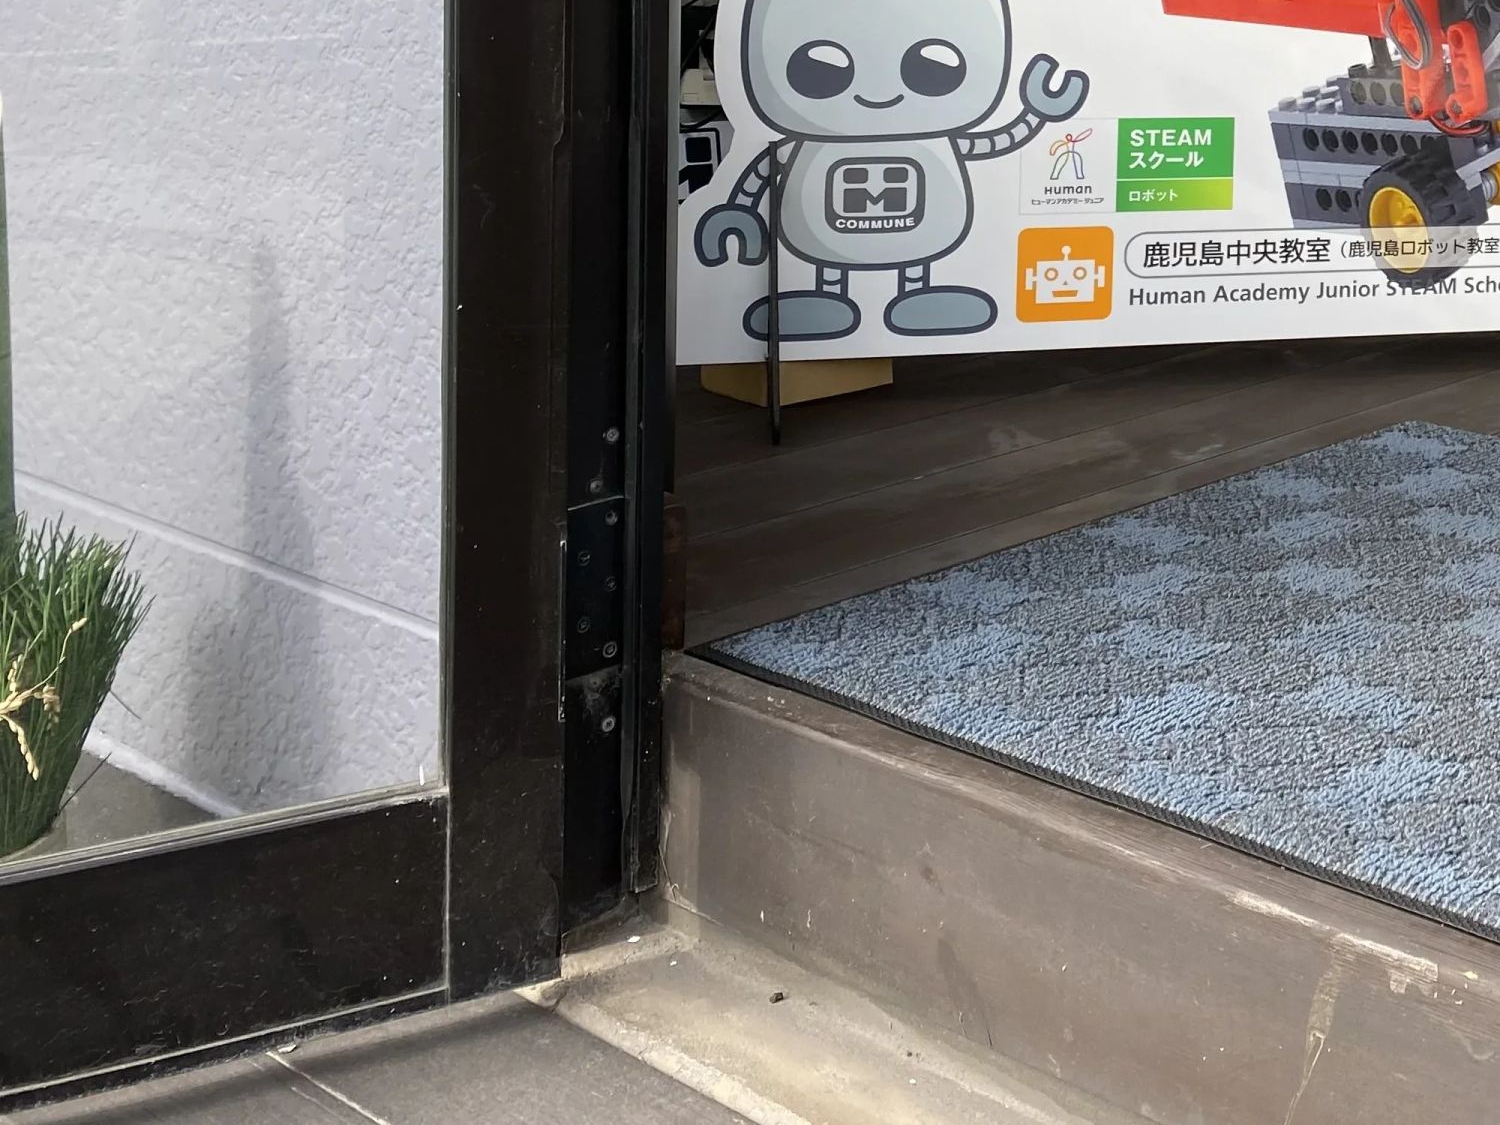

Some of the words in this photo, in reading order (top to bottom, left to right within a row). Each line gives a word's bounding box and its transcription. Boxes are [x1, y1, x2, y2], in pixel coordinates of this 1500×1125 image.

[1129, 128, 1212, 147] STEAM
[1128, 150, 1204, 170] スクール
[1044, 184, 1093, 195] Human
[1129, 188, 1178, 202] ロボット
[835, 217, 915, 229] COMMUNE
[1143, 237, 1331, 268] 鹿児島中央教室
[1129, 287, 1206, 306] Human
[1213, 282, 1310, 304] Academy
[1316, 281, 1380, 299] Junior
[1386, 276, 1457, 296] STEAM
